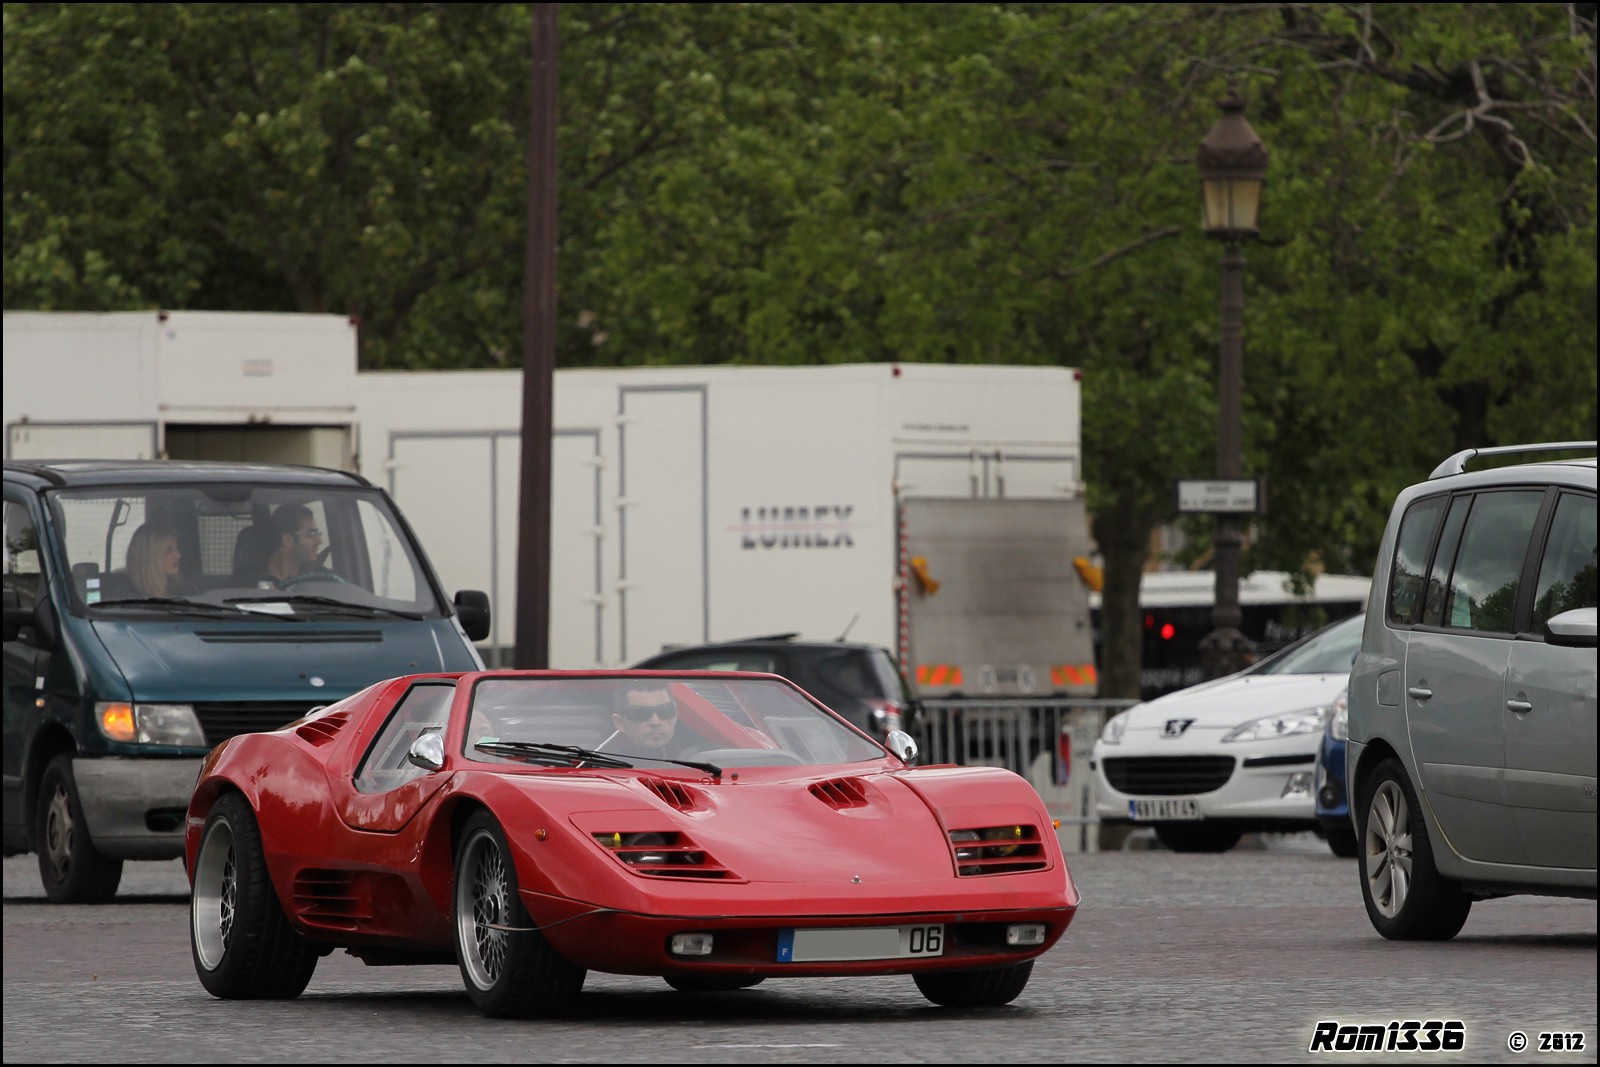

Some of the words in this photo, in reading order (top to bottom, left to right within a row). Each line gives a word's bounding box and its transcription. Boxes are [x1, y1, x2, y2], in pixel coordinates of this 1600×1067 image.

[742, 505, 854, 549] LUMEX
[781, 947, 788, 956] F
[909, 926, 942, 954] 06
